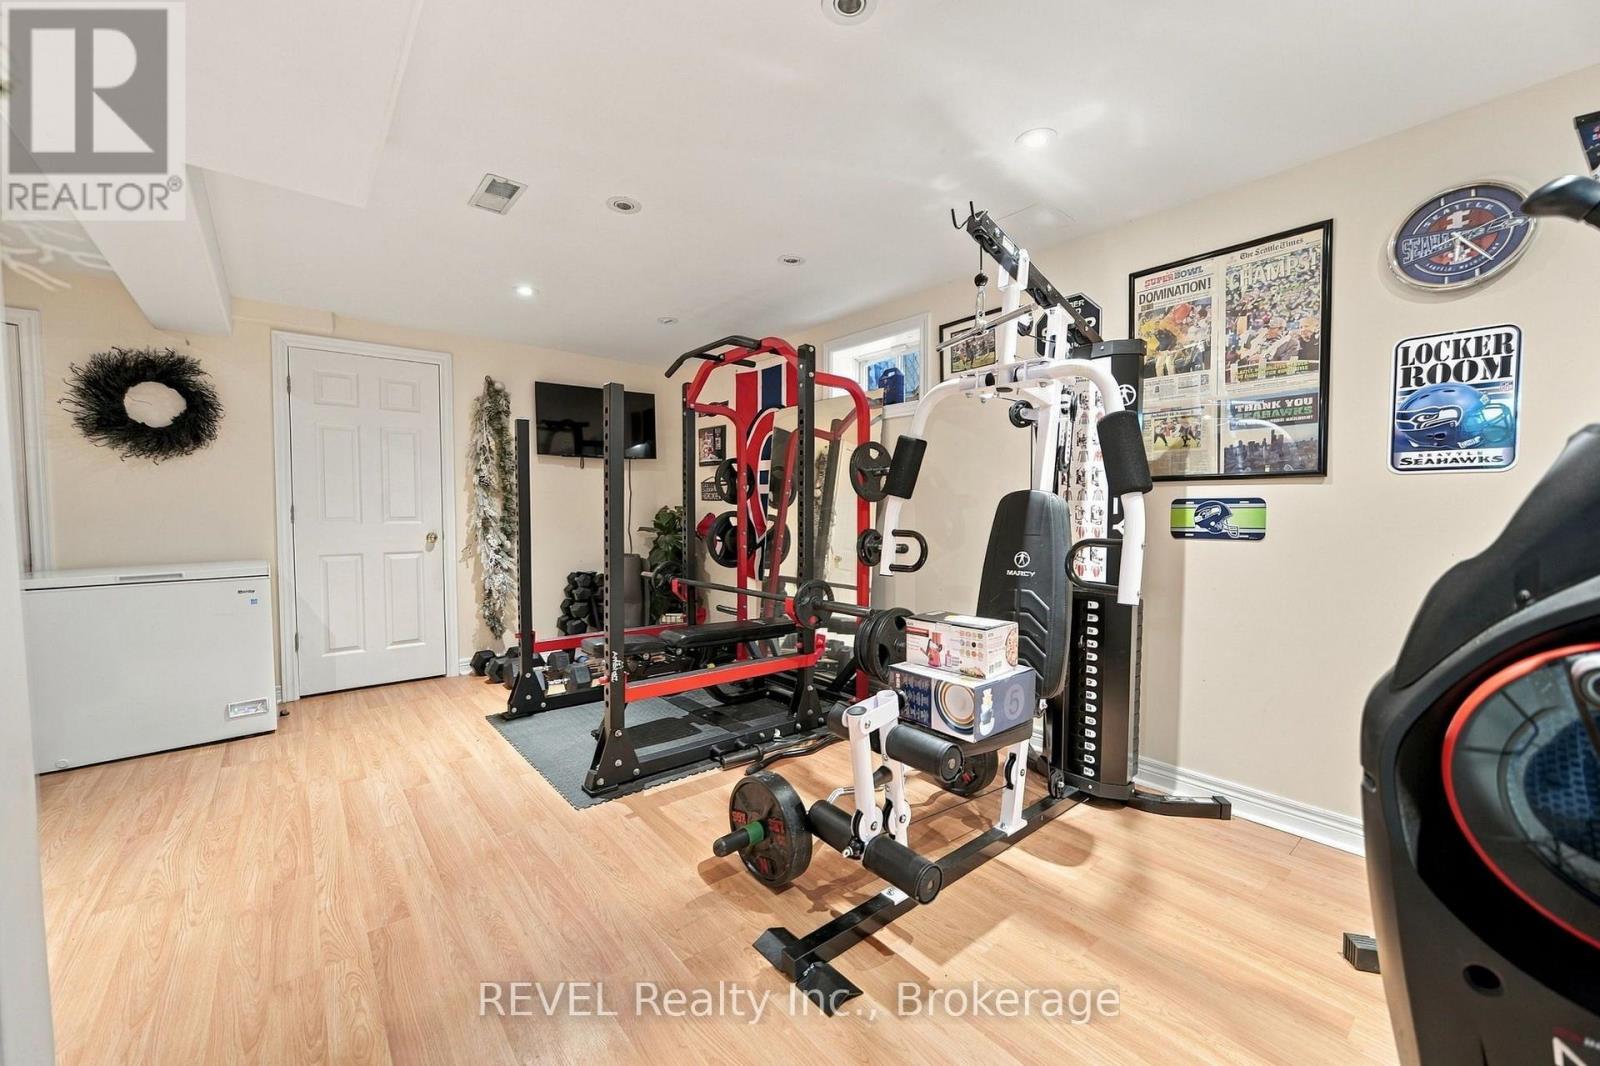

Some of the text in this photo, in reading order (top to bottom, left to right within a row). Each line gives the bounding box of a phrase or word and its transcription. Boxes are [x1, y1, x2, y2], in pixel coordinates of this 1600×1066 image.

[1280, 238, 1304, 250] Times
[1144, 265, 1204, 288] SUPER BOWL
[1138, 276, 1212, 306] DOMINATION!
[1400, 332, 1515, 367] LOCKER
[1400, 354, 1513, 389] ROOM
[1234, 397, 1314, 412] THANK YOU
[1400, 455, 1505, 466] SEAHAWKS
[1006, 569, 1036, 578] MARCY
